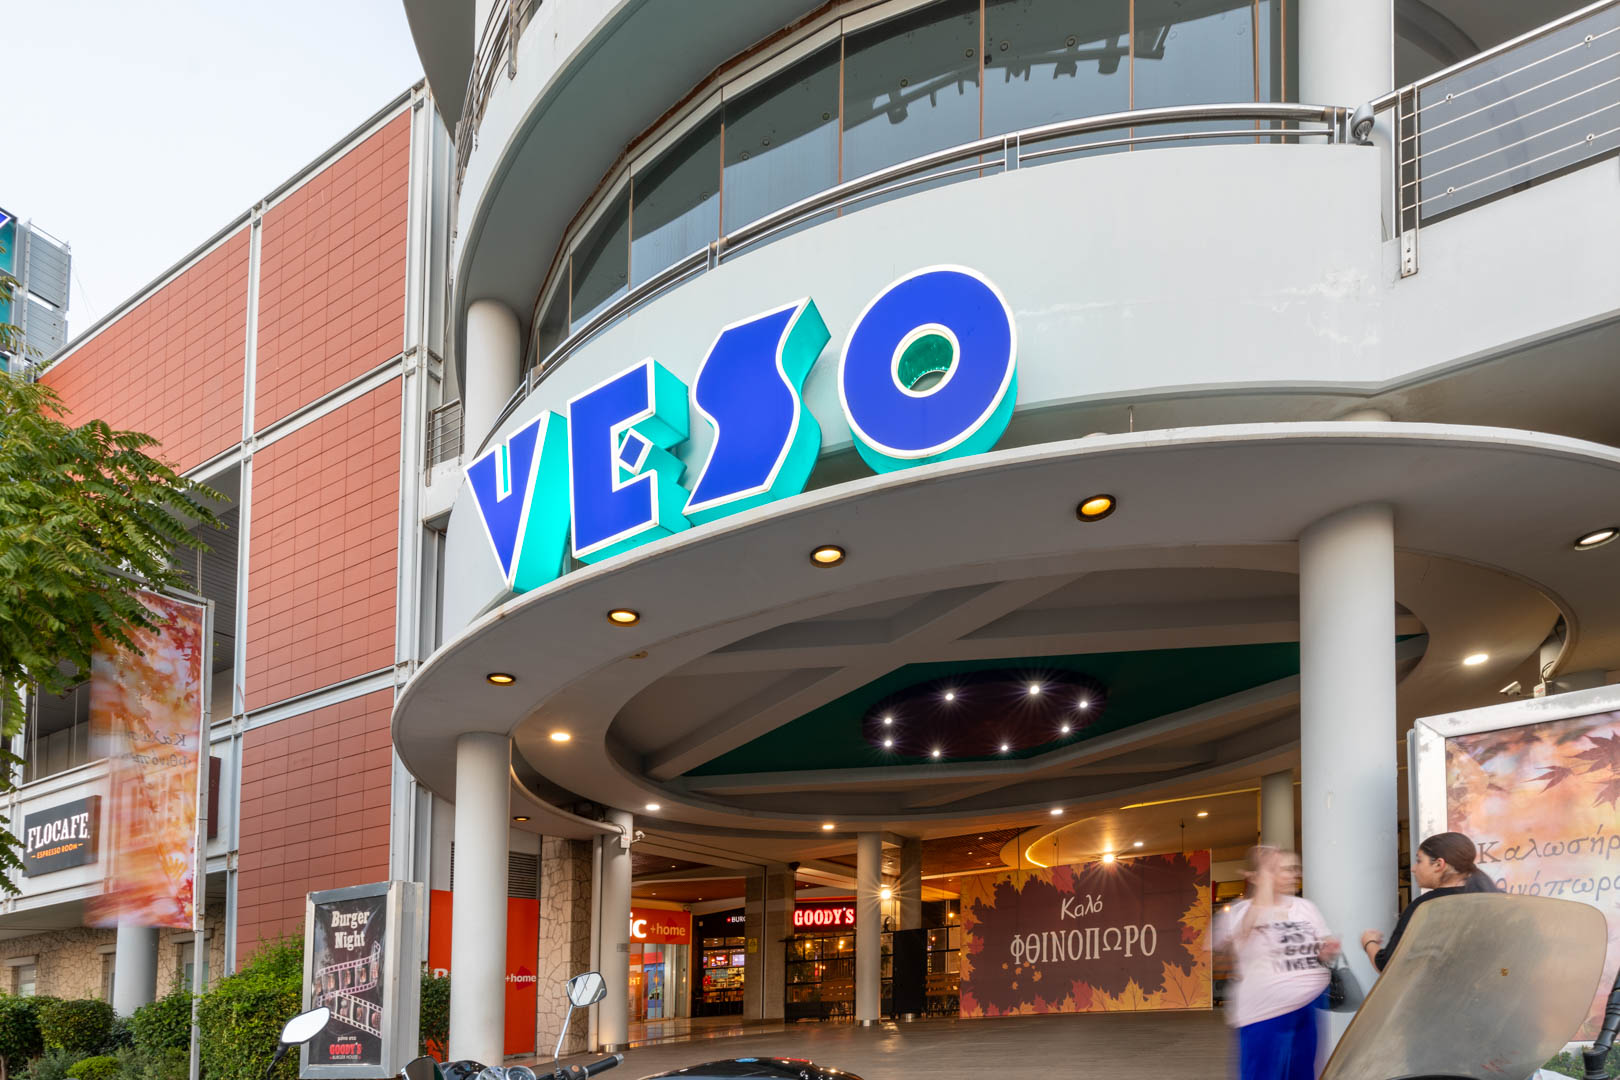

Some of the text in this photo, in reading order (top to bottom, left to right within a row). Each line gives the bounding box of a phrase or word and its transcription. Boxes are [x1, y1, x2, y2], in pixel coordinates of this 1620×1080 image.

[465, 263, 1018, 593] VESO
[36, 843, 78, 859] ESPRESSO ROOM
[794, 907, 855, 926] GOODY'S
[1060, 894, 1103, 920] Καλό
[331, 911, 370, 929] Burger
[334, 930, 365, 951] Night
[1010, 924, 1157, 965] ΦΘΙΝΟΠΩΡΟ
[329, 1042, 363, 1055] GOODY'S
